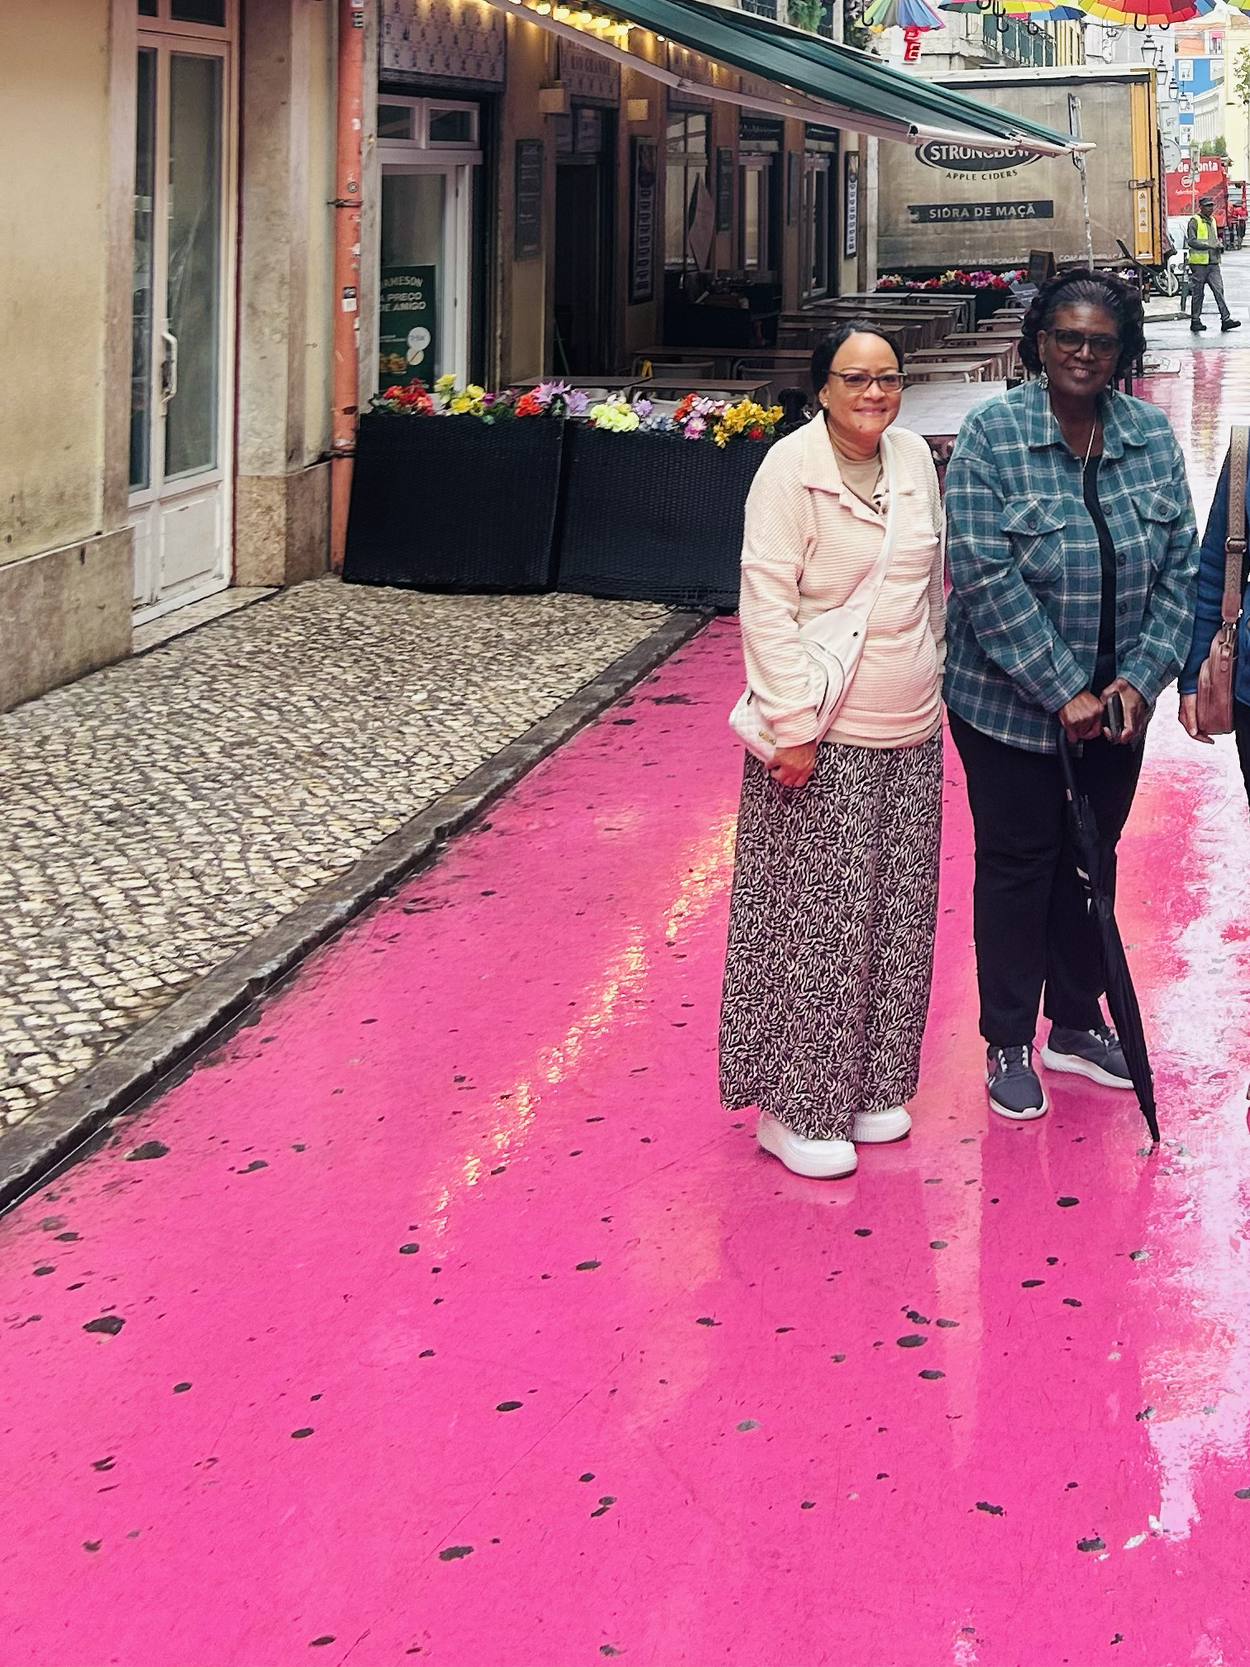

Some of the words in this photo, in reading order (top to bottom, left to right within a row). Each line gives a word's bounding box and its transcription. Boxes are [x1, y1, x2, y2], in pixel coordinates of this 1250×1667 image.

[1197, 161, 1219, 172] onta
[946, 171, 977, 181] APPLE
[981, 169, 1018, 180] CIDERS
[974, 206, 992, 217] DE
[995, 203, 1036, 218] MAÇÃ
[978, 255, 1030, 265] RESPONSÁVE
[392, 301, 427, 311] AMIGO
